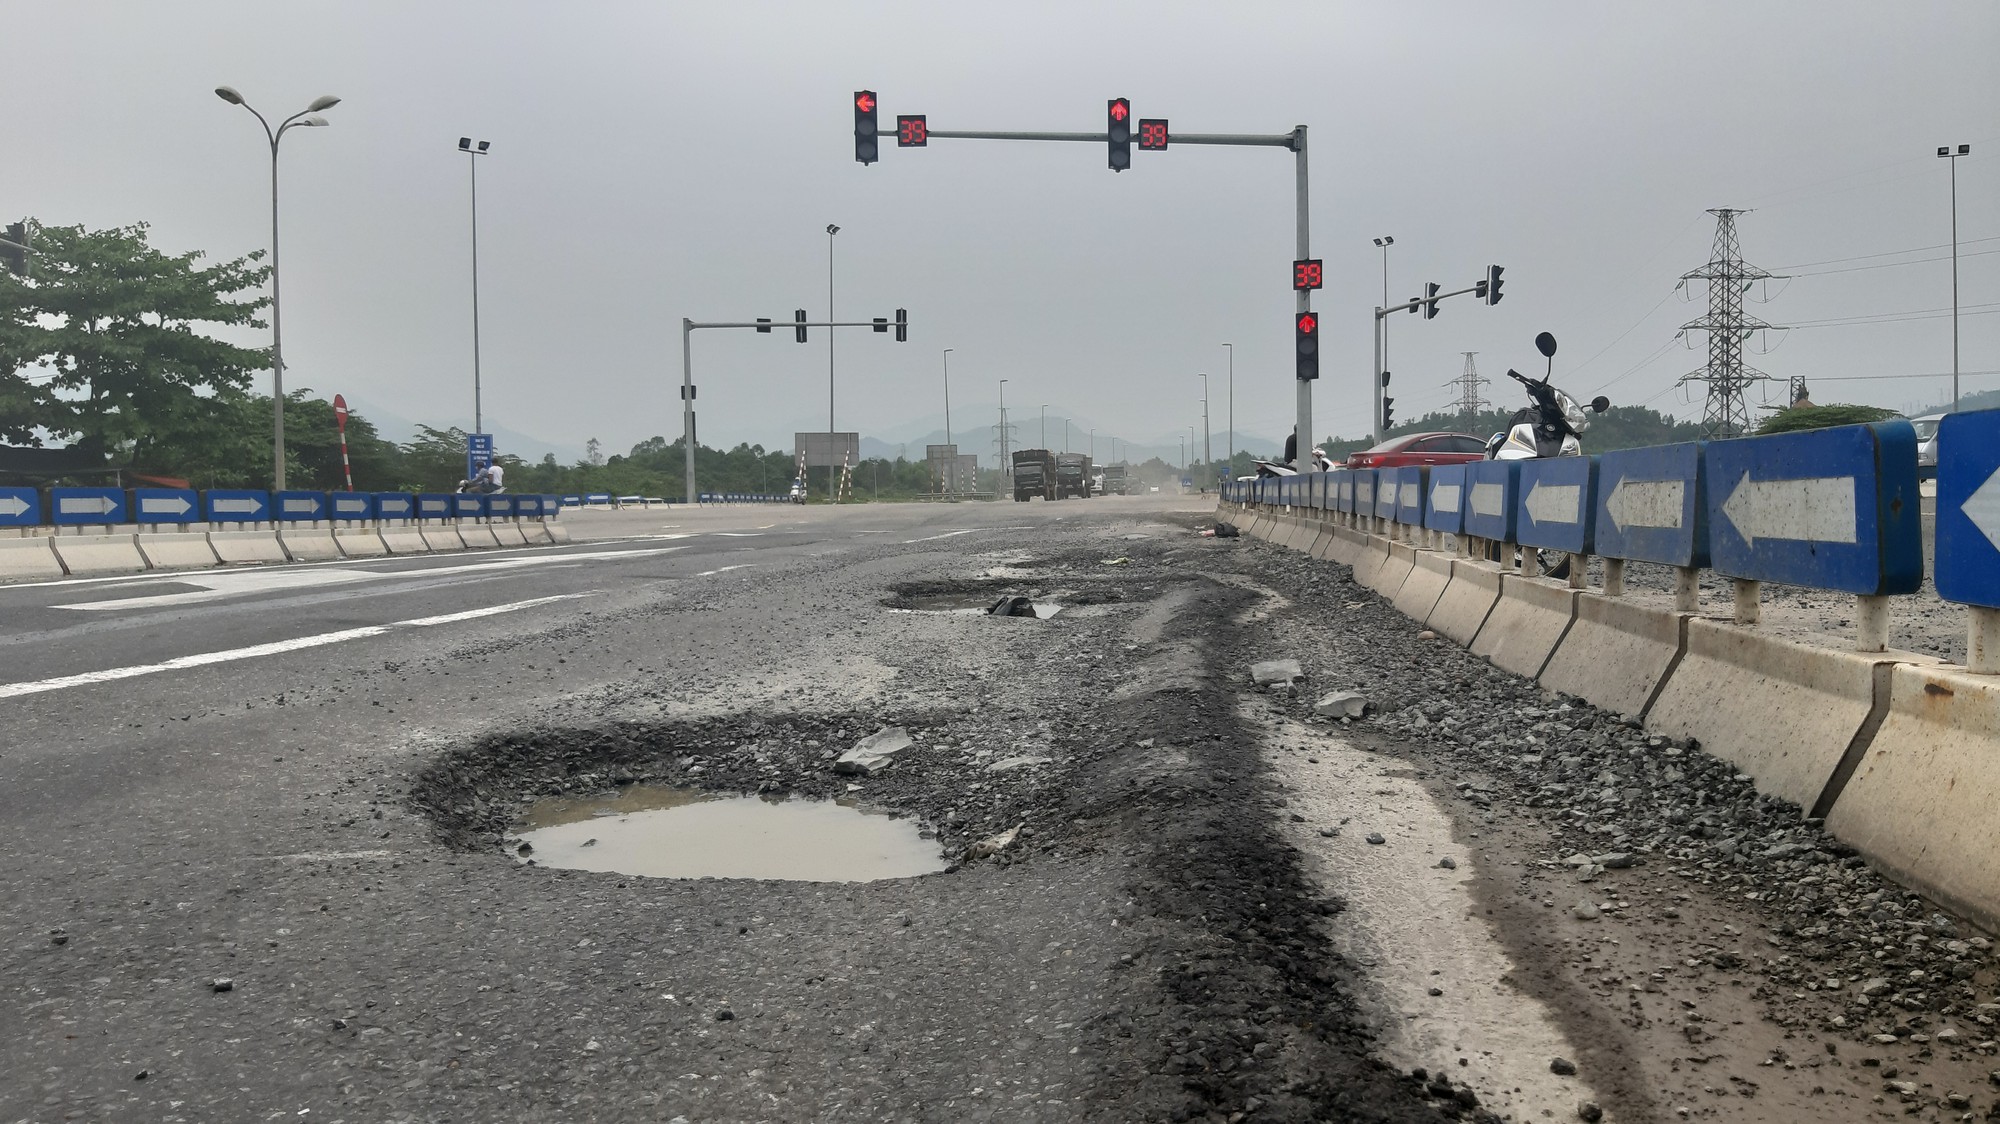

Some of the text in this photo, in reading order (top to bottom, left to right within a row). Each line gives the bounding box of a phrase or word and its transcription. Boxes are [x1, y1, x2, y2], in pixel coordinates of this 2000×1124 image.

[901, 119, 926, 143] 39
[1142, 123, 1167, 147] 39
[1297, 263, 1321, 287] 39
